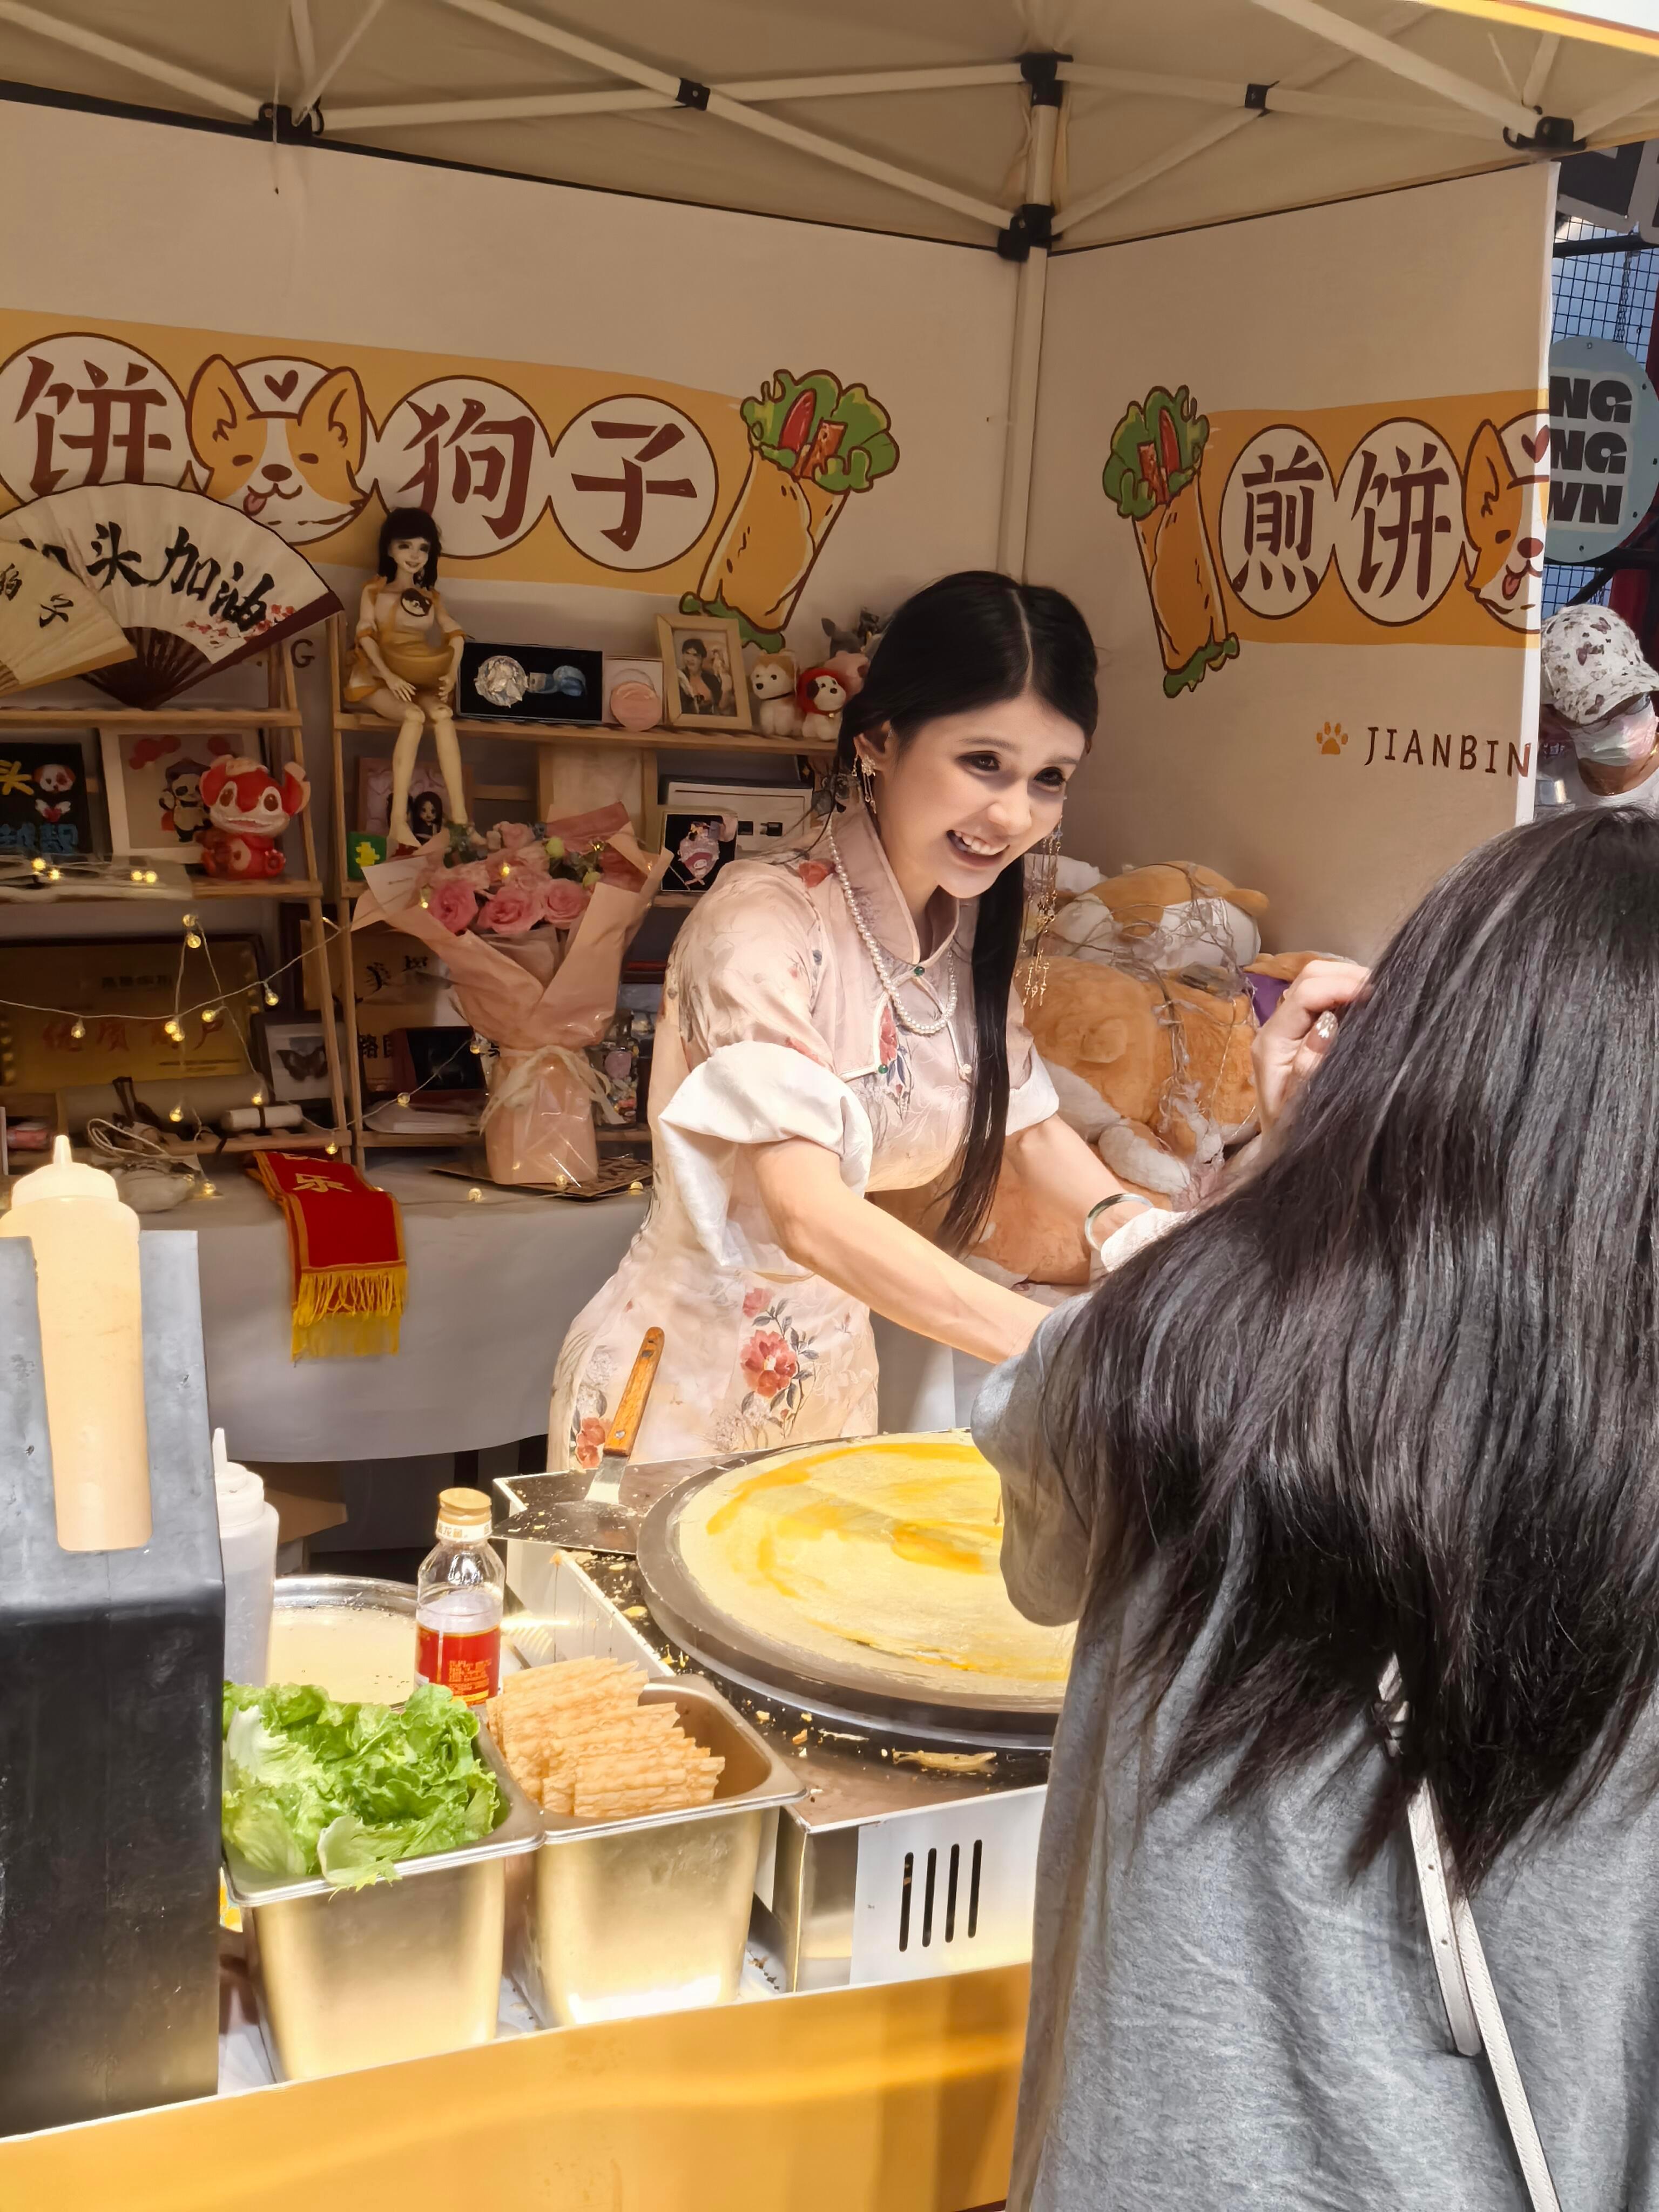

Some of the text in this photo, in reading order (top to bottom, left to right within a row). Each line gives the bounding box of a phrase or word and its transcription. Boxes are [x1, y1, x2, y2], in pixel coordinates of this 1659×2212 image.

[14, 355, 698, 552] 饼 狗子
[1232, 443, 1452, 601] 煎饼
[1364, 727, 1532, 778] JIANBIN
